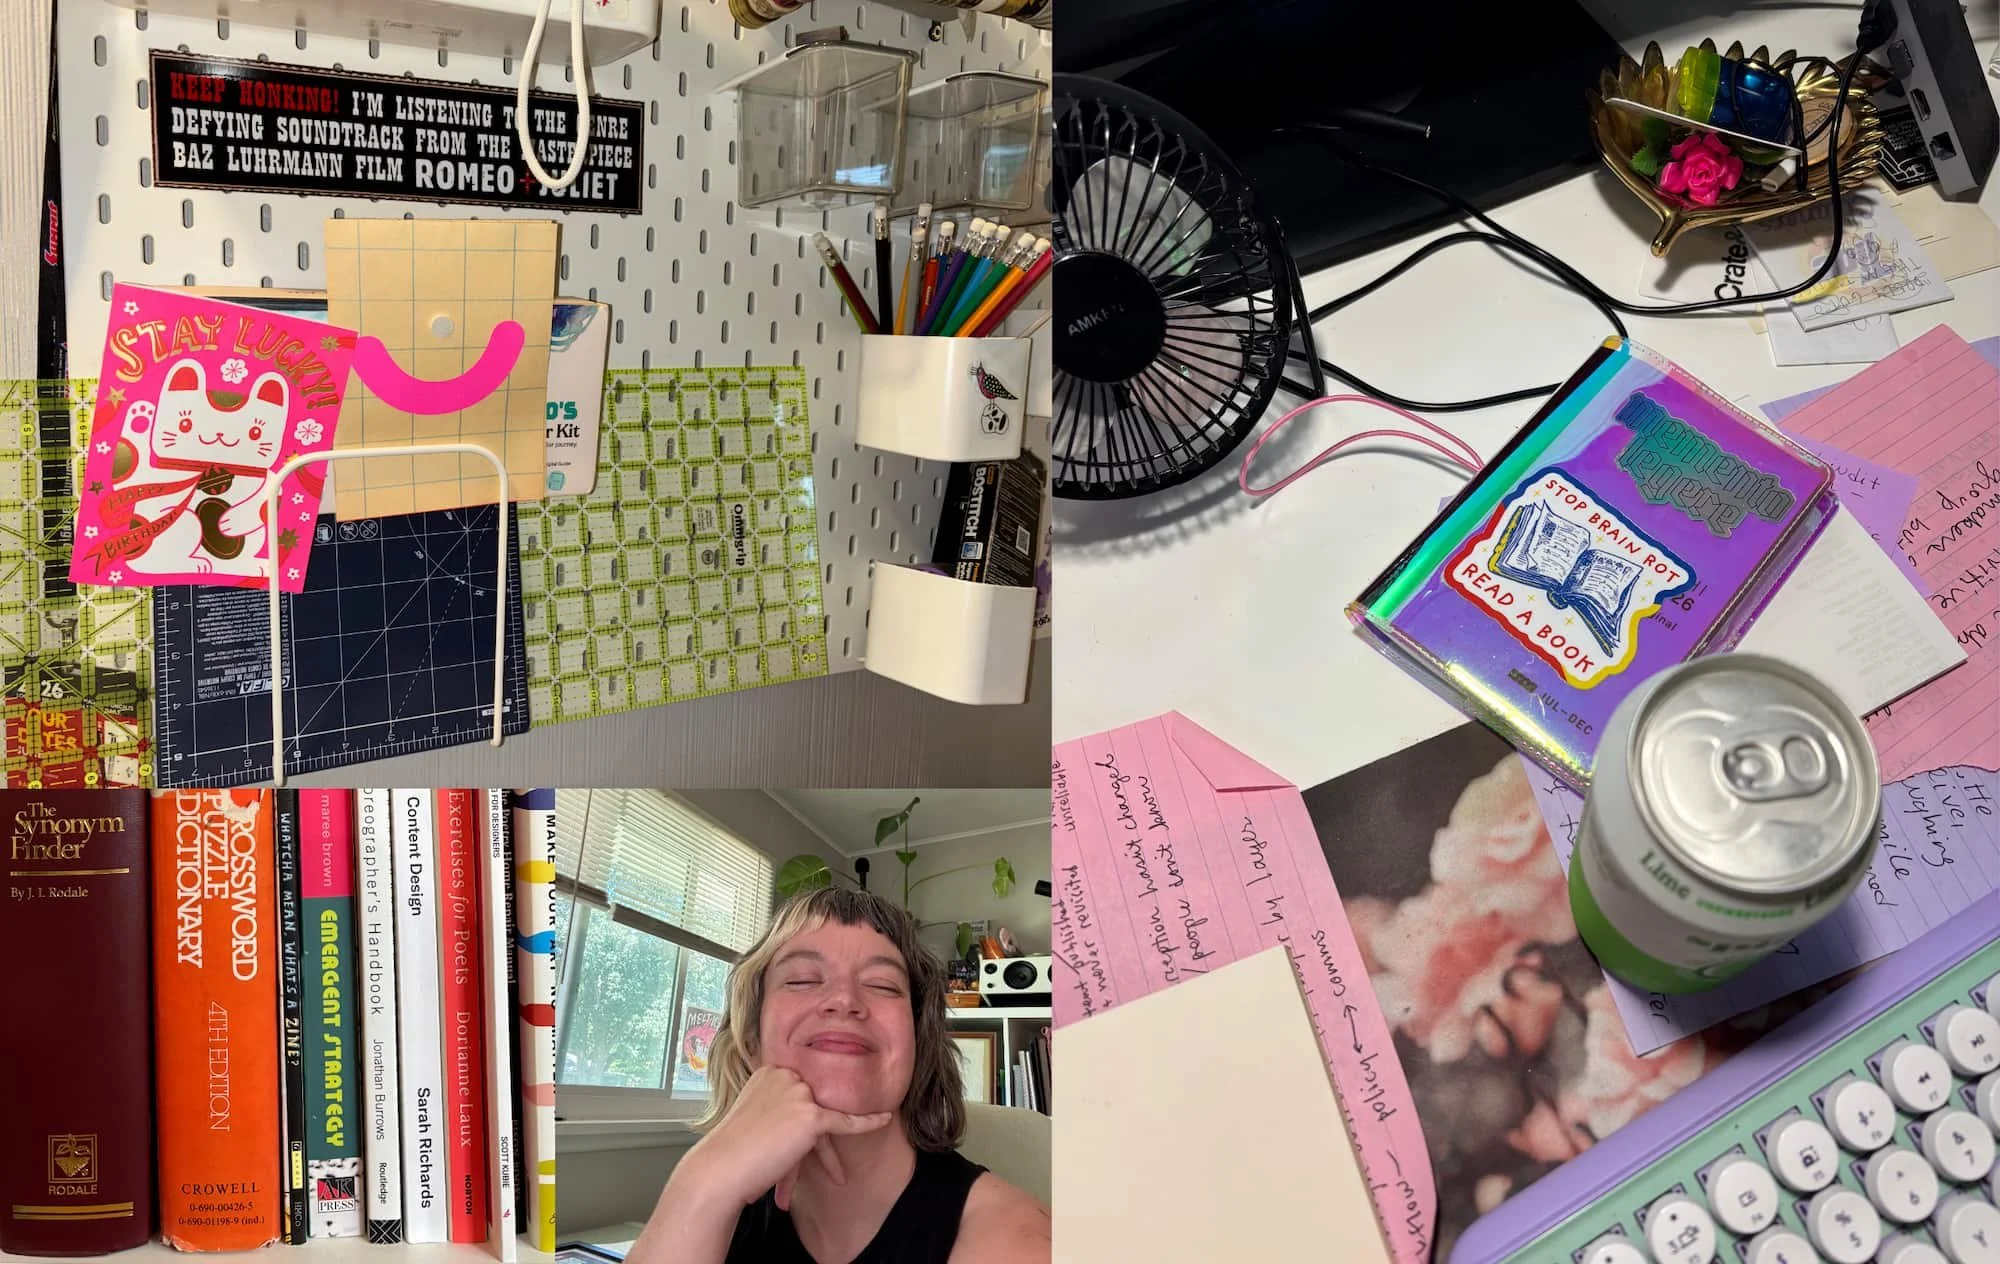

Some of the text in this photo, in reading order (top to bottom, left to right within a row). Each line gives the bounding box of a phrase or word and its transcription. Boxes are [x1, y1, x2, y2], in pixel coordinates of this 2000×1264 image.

[170, 71, 629, 141] KEEP HONKING! I'M LISTENING T THE NRE
[171, 106, 633, 169] DEFYING SOUNDTRACK FROM THE ASTEPIECE
[172, 140, 214, 170] BAZ
[226, 144, 343, 178] LUHRMANN
[355, 154, 404, 183] FILM
[415, 158, 515, 194] ROMEO
[109, 313, 340, 411] STAY LUCKY!
[964, 465, 988, 538] BOSTITCH
[1545, 478, 1681, 584] STOP BRAIN ROT
[104, 509, 178, 559] BIRTHDAY
[734, 503, 747, 567] Omnigrip
[1461, 562, 1596, 674] READ A BOOK
[27, 801, 57, 818] The
[1094, 752, 1138, 830] changed
[1963, 783, 1992, 816] He
[10, 834, 87, 860] Finder
[14, 810, 126, 844] Synonym
[320, 794, 334, 887] maree brown
[407, 796, 422, 916] Content Design
[490, 800, 500, 859] FOR DESIGNERS
[546, 814, 555, 865] MAKE
[11, 887, 25, 901] By
[48, 886, 89, 899] Rodale
[175, 790, 259, 981] ROSSWORD PUZZLE DICTIONARY
[362, 788, 384, 1015] oreographer's Handbook
[448, 791, 471, 985] Exercises for Poets
[1639, 848, 1692, 900] Lime
[1310, 929, 1348, 997] comms
[285, 1017, 300, 1067] ZINE?
[320, 909, 344, 1147] EMERGENT STRATEGY
[208, 1000, 231, 1132] 4TH EDITION
[373, 1038, 386, 1141] Jonathan Burrows
[456, 1011, 474, 1149] Dorianne Laux
[1359, 1052, 1398, 1121] policy
[417, 1087, 434, 1209] Sarah Richards
[500, 1136, 510, 1188] SCOTT KUBIE
[48, 1183, 98, 1196] RODALE
[181, 1182, 261, 1196] CROWELL
[189, 1201, 254, 1213] 0-690-00426-5
[320, 1200, 354, 1211] PRESS
[378, 1162, 387, 1205] Routledge
[464, 1174, 473, 1215] NORTON
